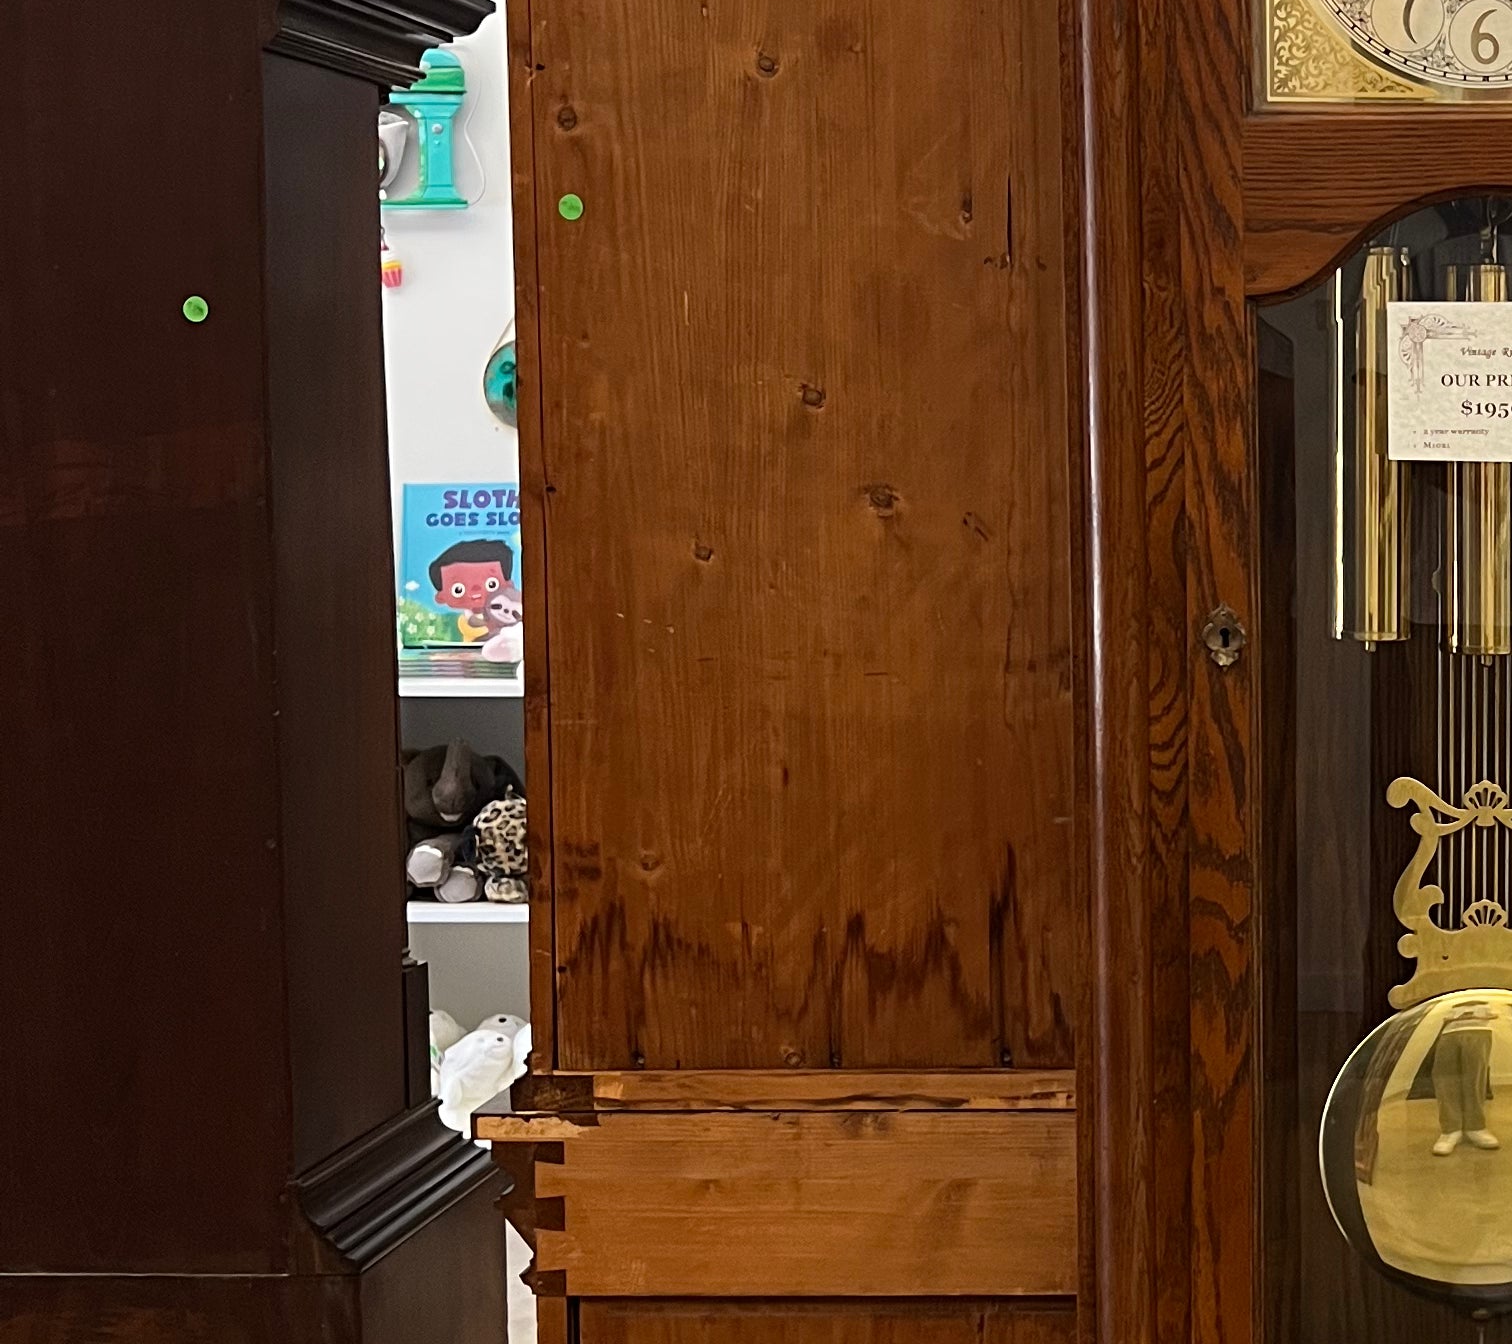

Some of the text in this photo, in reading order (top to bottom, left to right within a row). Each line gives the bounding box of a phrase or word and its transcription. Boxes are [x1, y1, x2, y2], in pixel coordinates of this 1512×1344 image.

[1470, 8, 1500, 65] 6
[1460, 347, 1496, 359] Vintage
[1441, 374, 1480, 387] OUR
[443, 489, 520, 509] SLOTH
[426, 512, 520, 527] GOES SLO
